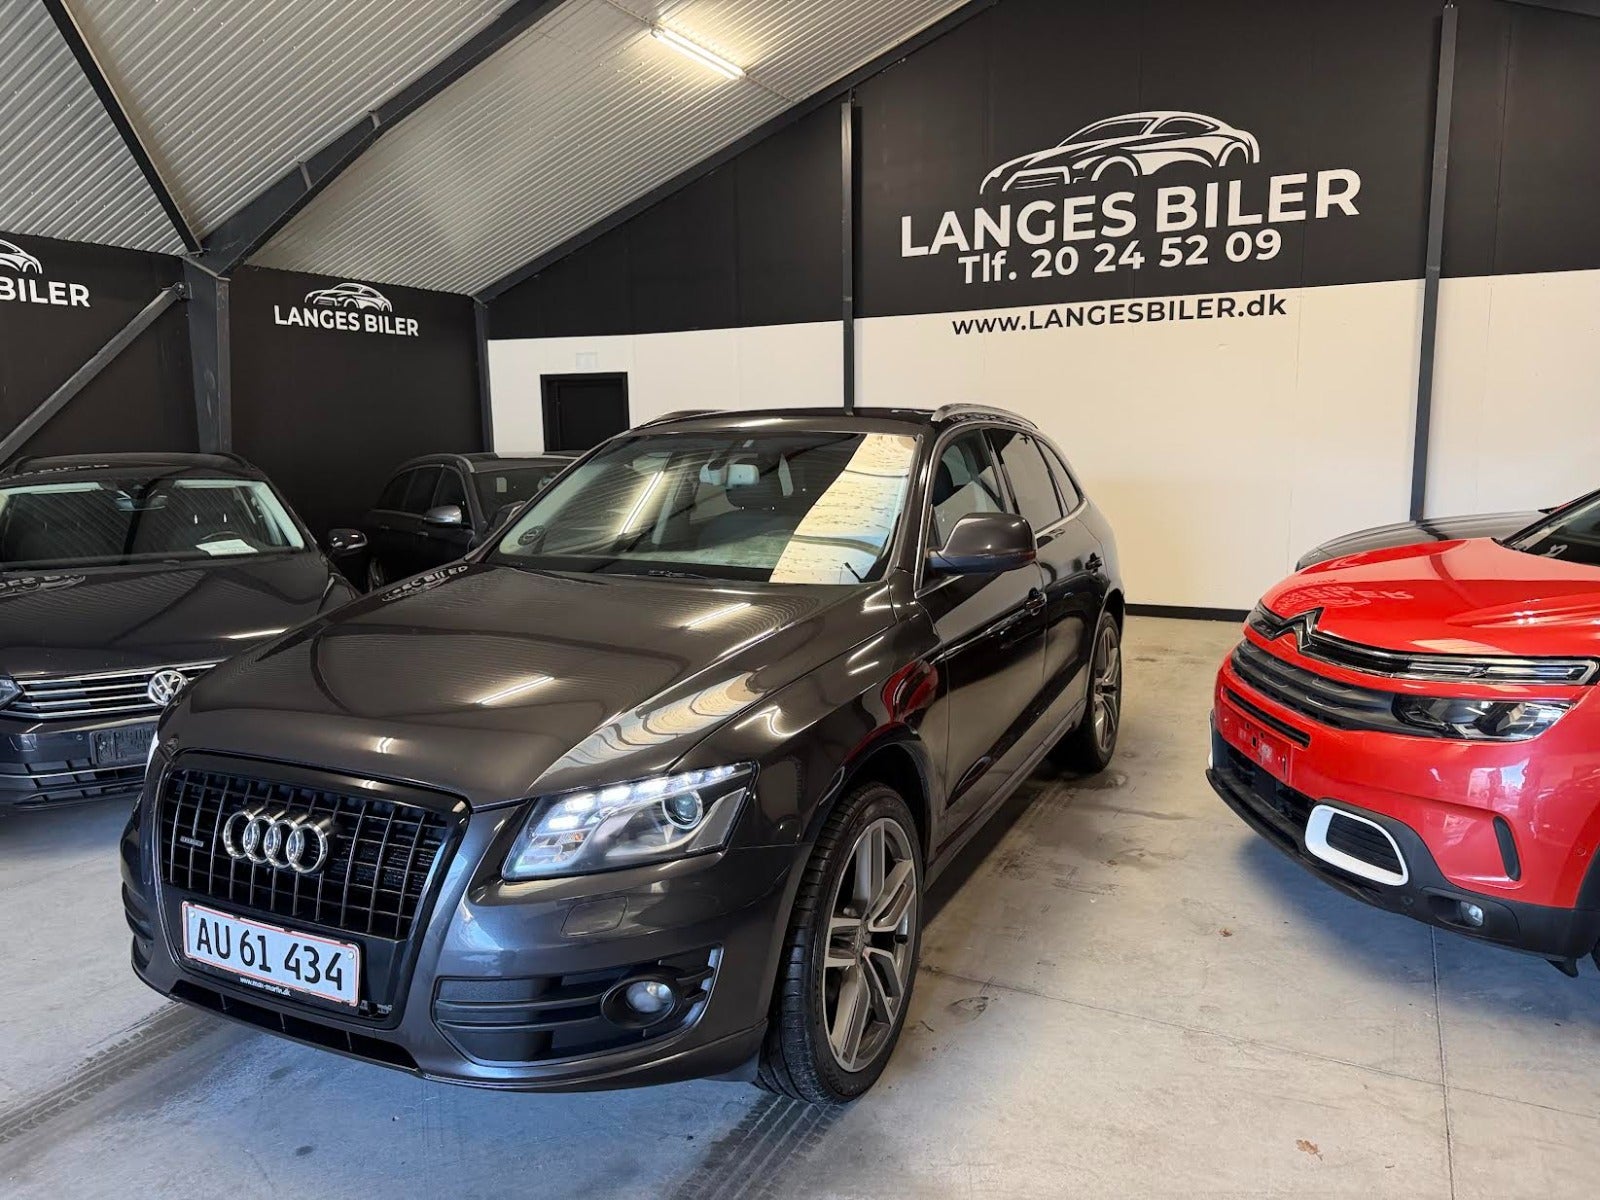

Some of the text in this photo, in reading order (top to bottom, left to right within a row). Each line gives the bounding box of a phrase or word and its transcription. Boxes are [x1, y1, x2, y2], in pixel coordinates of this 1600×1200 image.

[901, 169, 1361, 257] LANGES BILER
[958, 229, 1282, 284] Tlf. 20 24 52 09
[0, 276, 90, 307] BILER
[952, 294, 1287, 335] www.LANGESBILER.dk
[274, 305, 419, 337] LANGES BILER
[197, 918, 343, 991] AU 61 434
